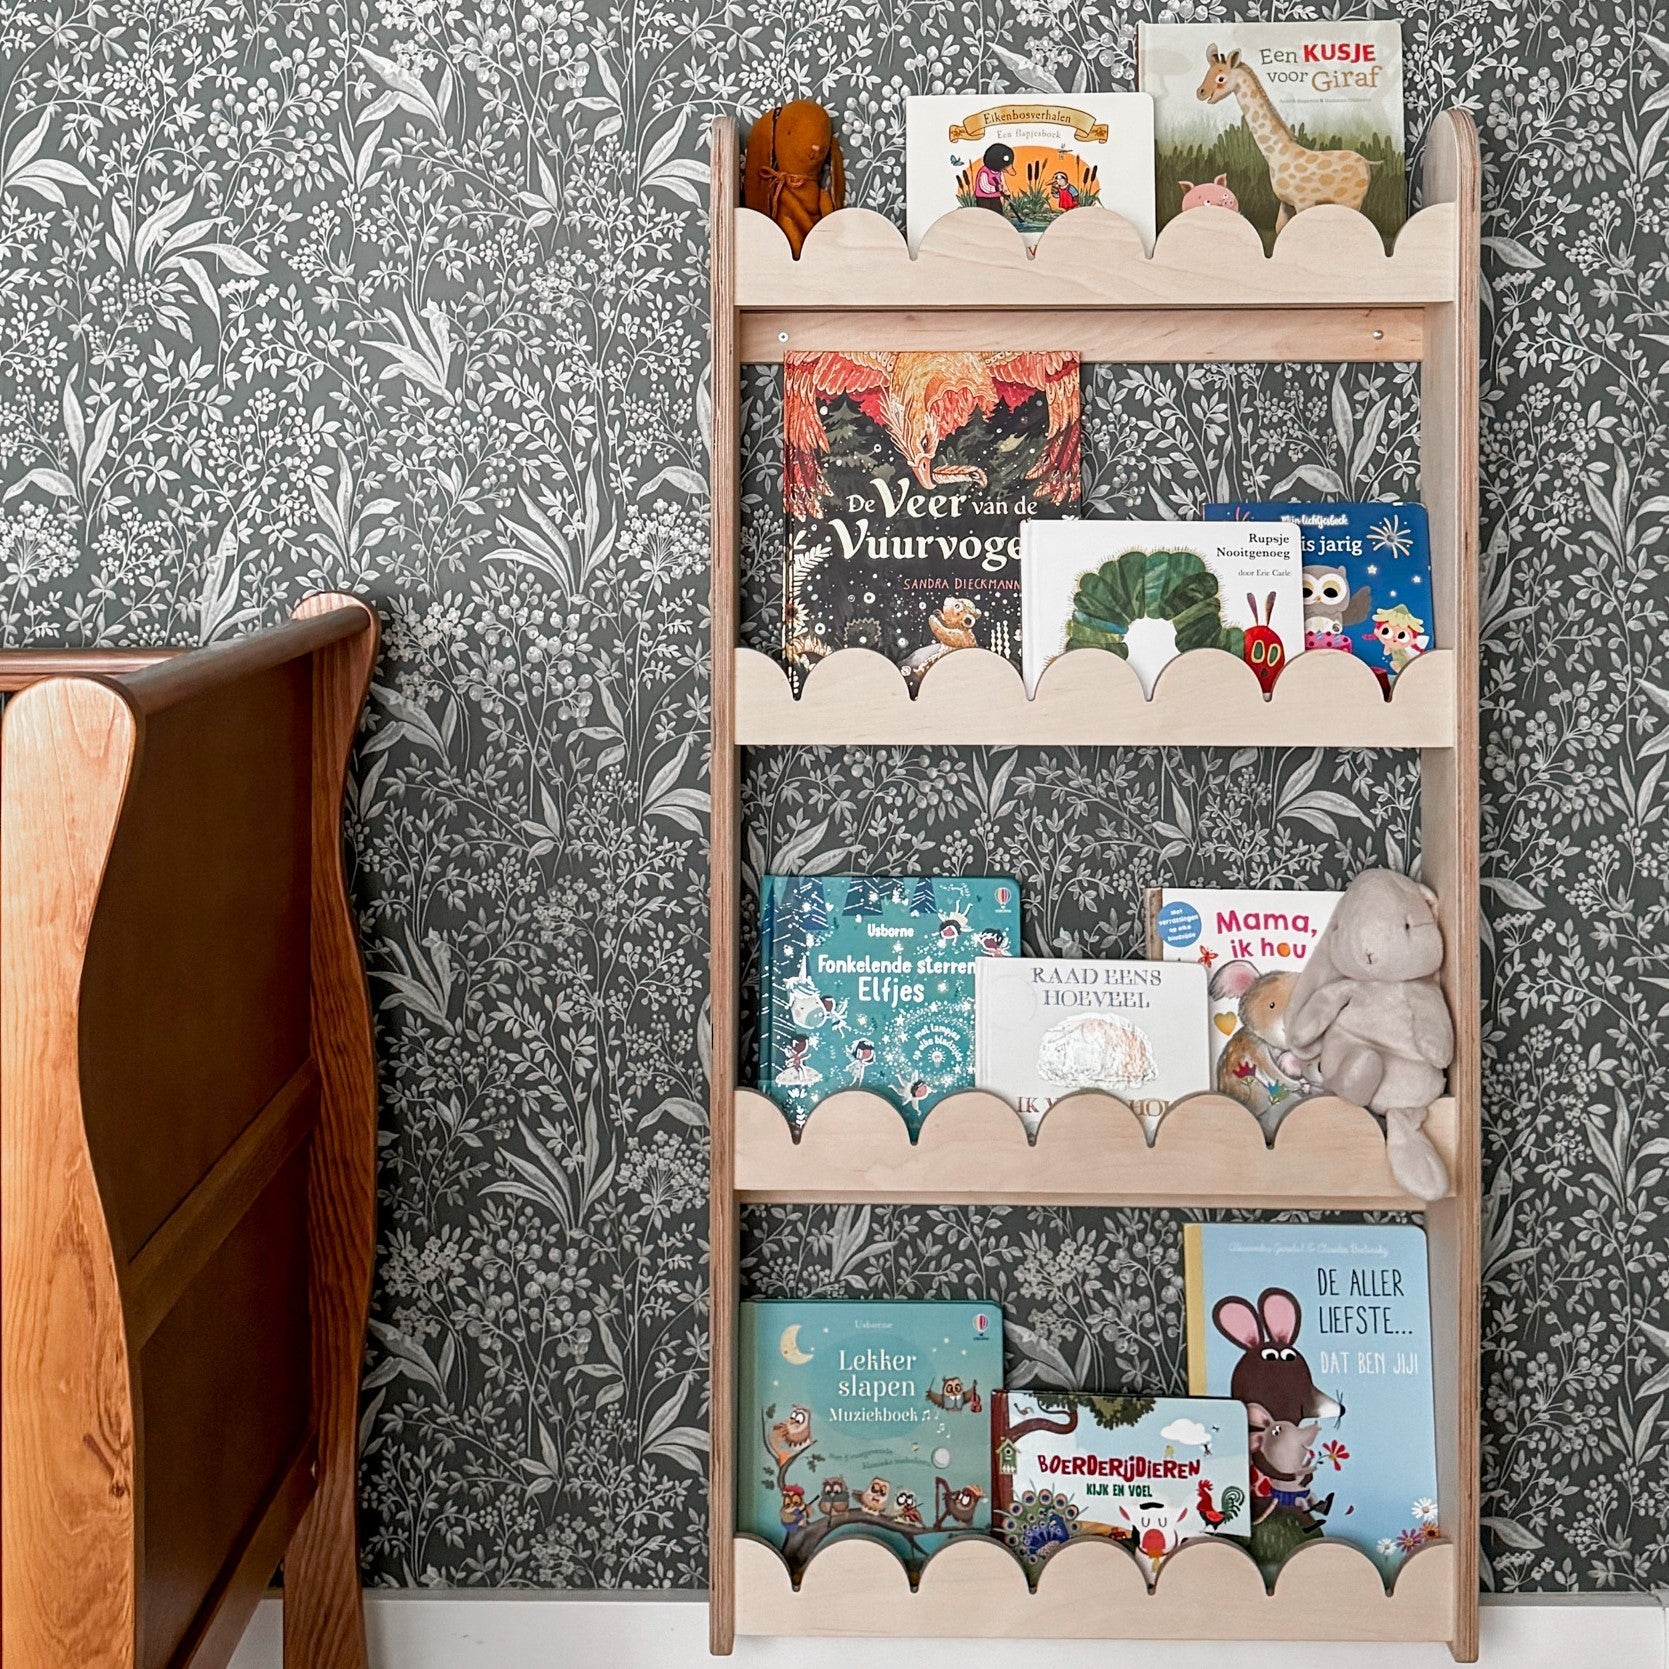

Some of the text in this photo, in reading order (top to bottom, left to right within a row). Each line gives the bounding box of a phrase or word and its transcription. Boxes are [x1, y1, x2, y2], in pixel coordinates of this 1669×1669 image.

[1260, 43, 1376, 65] Een KUSJE
[1267, 65, 1382, 92] voor Giraf
[983, 109, 1071, 124] Eikenbosverhalen
[997, 130, 1012, 139] Een
[846, 477, 1038, 518] De Veer van de
[828, 518, 1021, 571] Vuurvoge
[1249, 533, 1290, 546] Rupsje
[1317, 535, 1363, 556] jarig
[1216, 547, 1291, 560] Nooitgenoeg
[1238, 568, 1255, 577] door
[1256, 568, 1270, 577] Eric
[903, 578, 1021, 590] SANDRA DIECKMANN
[867, 924, 914, 938] Usborne
[1216, 910, 1317, 938] Mama,
[1230, 937, 1306, 959] ik hou
[818, 954, 976, 975] Fonkelende sterren
[1031, 967, 1162, 986] RAAD EENS
[858, 976, 925, 1007] Elfjes
[1043, 989, 1150, 1009] HOEVEEL
[1017, 1096, 1040, 1114] IK
[1130, 1099, 1173, 1117] HO
[1317, 1267, 1404, 1297] DE ALLER
[855, 1320, 893, 1330] Usborne
[1319, 1305, 1413, 1335] LIEFSTE...
[838, 1349, 917, 1371] Lekker
[1320, 1350, 1419, 1375] DAT BEN JIJI
[838, 1375, 915, 1402] slapen
[829, 1407, 918, 1422] Muziekboek
[1086, 1483, 1153, 1498] KIJK EN VOEL
